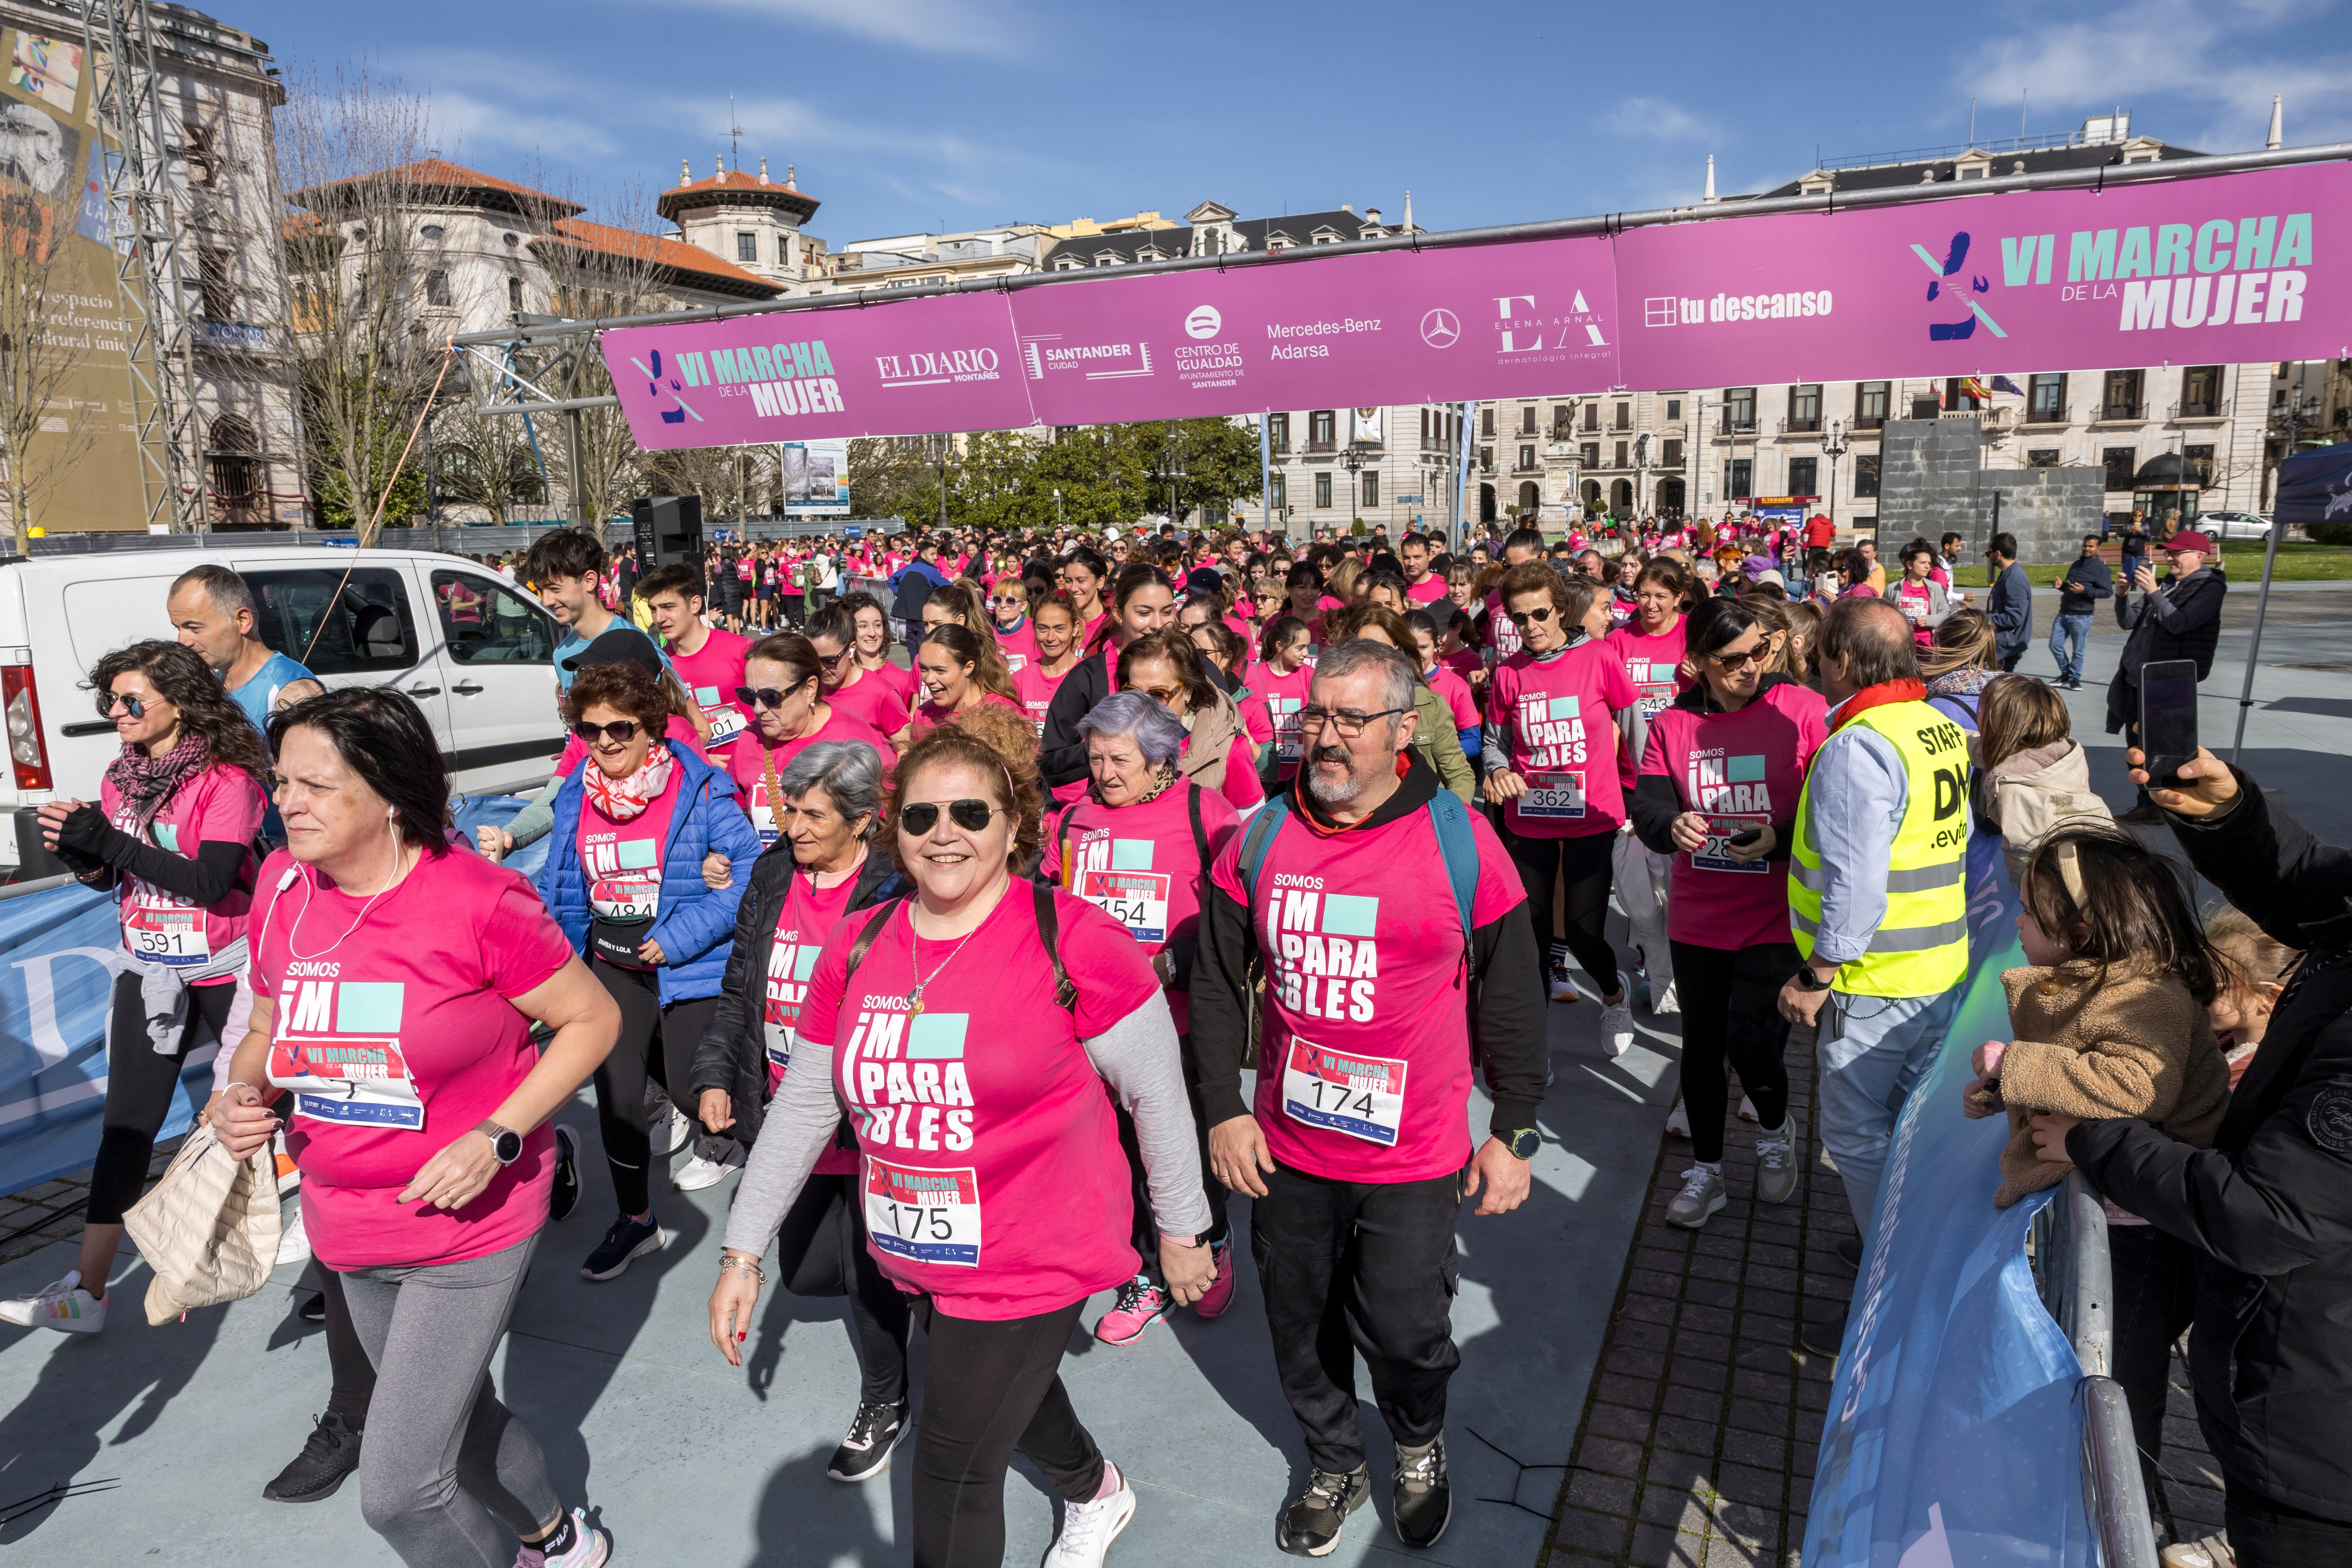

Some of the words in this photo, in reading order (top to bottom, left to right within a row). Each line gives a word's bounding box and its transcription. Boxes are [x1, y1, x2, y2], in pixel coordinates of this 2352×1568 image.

[2001, 233, 2055, 287] VI
[2067, 213, 2312, 282] MARCHA
[51, 292, 113, 309] espacio
[1680, 298, 1704, 324] tu
[1710, 290, 1832, 322] descanso
[2062, 286, 2087, 301] DE
[2093, 283, 2118, 299] LA
[2119, 270, 2307, 331] MUJER
[50, 311, 132, 332] referencia
[1267, 318, 1382, 338] Mercedes-Benz
[1495, 319, 1543, 330] ELENA
[1553, 314, 1603, 325] ARNAL
[1046, 344, 1132, 361] SANTANDER
[1175, 345, 1221, 358] CENTRO
[1224, 344, 1239, 354] DE
[1271, 344, 1330, 360] Adarsa
[1571, 350, 1611, 360] integral
[676, 352, 711, 387] VI
[710, 340, 835, 384] MARCHA
[876, 356, 909, 378] EL
[909, 348, 998, 376] DIARIO
[1048, 361, 1079, 370] CIUDAD
[1177, 356, 1243, 372] IGUALDAD
[955, 371, 1000, 382] MONTAÑÉS
[1179, 370, 1233, 380] AYUNTAMIENTO
[1192, 380, 1237, 389] SANTANDER
[719, 387, 733, 397] DE
[736, 385, 748, 395] LA
[749, 378, 845, 417] MUJER
[1519, 692, 1547, 702] SOMOS
[1640, 698, 1668, 711] 543
[717, 710, 736, 721] MUJER
[712, 719, 733, 738] 01
[1530, 719, 1586, 746] PARA
[1917, 723, 1963, 755] STAFF
[1536, 741, 1587, 767] BLES
[1689, 747, 1724, 760] SOMOS
[1533, 790, 1570, 807] 362
[1701, 783, 1772, 813] PARA
[585, 832, 617, 844] SOMOS
[1081, 828, 1110, 842] SOMOS
[615, 884, 623, 894] VI
[624, 884, 659, 894] MARCHA
[1108, 877, 1116, 888] VI
[1117, 878, 1156, 890] MARCHA
[1274, 874, 1324, 890] SOMOS
[632, 892, 659, 903] MUJER
[1126, 888, 1156, 901] MUJER
[146, 912, 153, 922] VI
[155, 913, 193, 923] MARCHA
[1099, 899, 1146, 925] 154
[163, 923, 193, 932] MUJER
[774, 927, 798, 942] OMOS
[140, 932, 182, 953] 591
[598, 938, 611, 949] BIMBA
[616, 945, 631, 954] LOLA
[1282, 934, 1378, 978] PARA
[286, 961, 341, 977] SOMOS
[862, 995, 911, 1011] SOMOS
[1285, 969, 1375, 1022] BLES
[780, 1005, 790, 1016] VI
[306, 1048, 323, 1064] VI
[326, 1048, 388, 1064] MARCHA
[342, 1063, 389, 1079] MUJER
[1323, 1055, 1335, 1070] VI
[1338, 1059, 1389, 1080] MARCHA
[860, 1062, 975, 1106] PARA
[1348, 1074, 1388, 1093] MUJER
[1312, 1081, 1374, 1119] 174
[870, 1103, 974, 1151] BLES
[891, 1172, 903, 1188] VI
[904, 1174, 959, 1191] MARCHA
[916, 1190, 961, 1205] MUJER
[888, 1203, 953, 1240] 175
[544, 1524, 569, 1553] FILA
